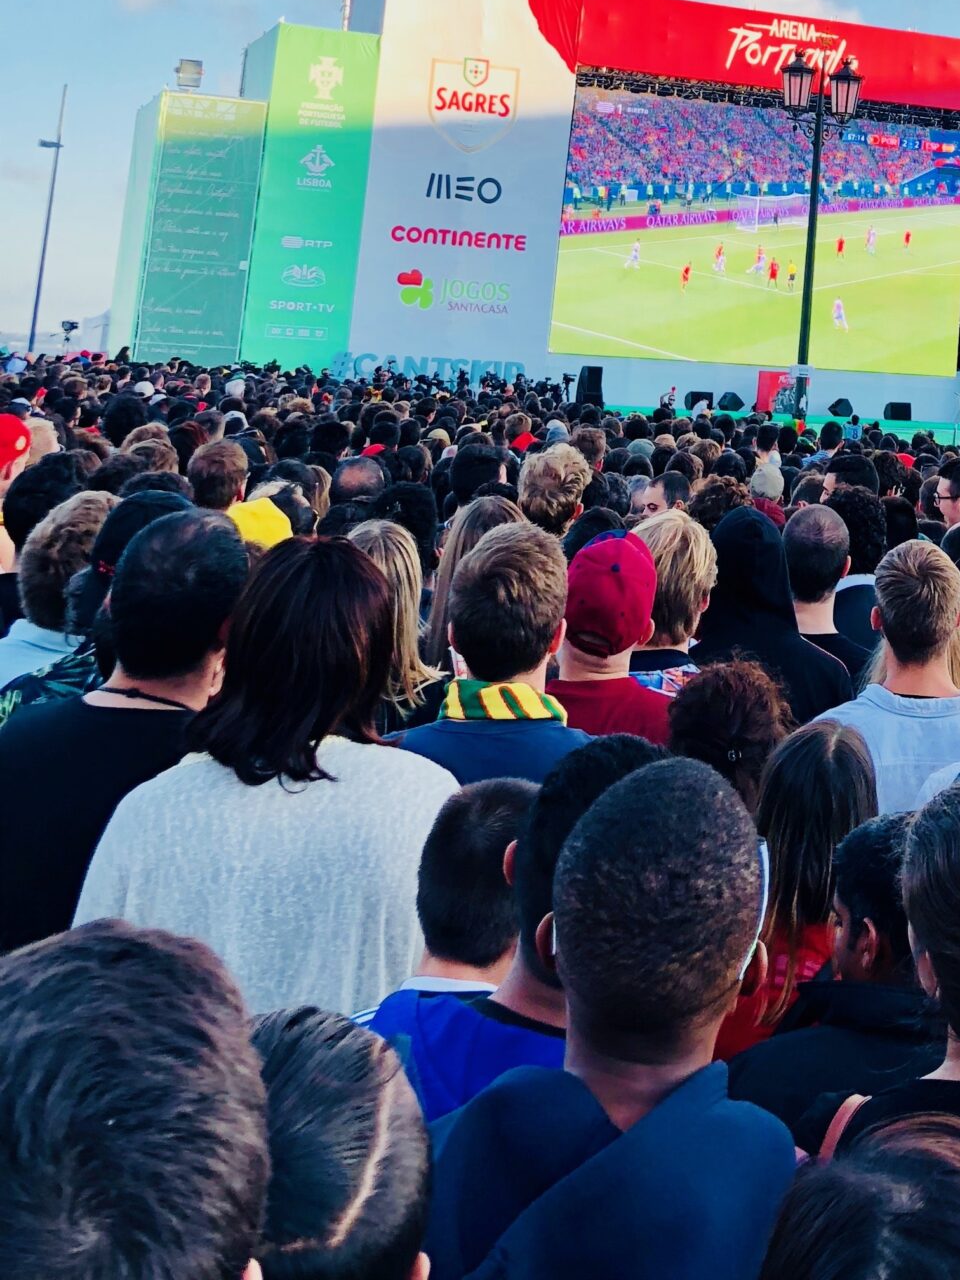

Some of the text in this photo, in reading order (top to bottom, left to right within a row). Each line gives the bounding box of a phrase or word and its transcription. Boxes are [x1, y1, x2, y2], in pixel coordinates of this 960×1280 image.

[768, 18, 817, 43] ARENA
[434, 86, 510, 118] SAGRES
[296, 177, 332, 189] LISBOA
[426, 173, 502, 204] MEO
[578, 217, 627, 234] AIRWAYS
[646, 209, 718, 229] QATAR AIRWAYS
[304, 239, 333, 249] RTP
[391, 225, 527, 251] CONTINENTE
[440, 279, 511, 305] JOGOS
